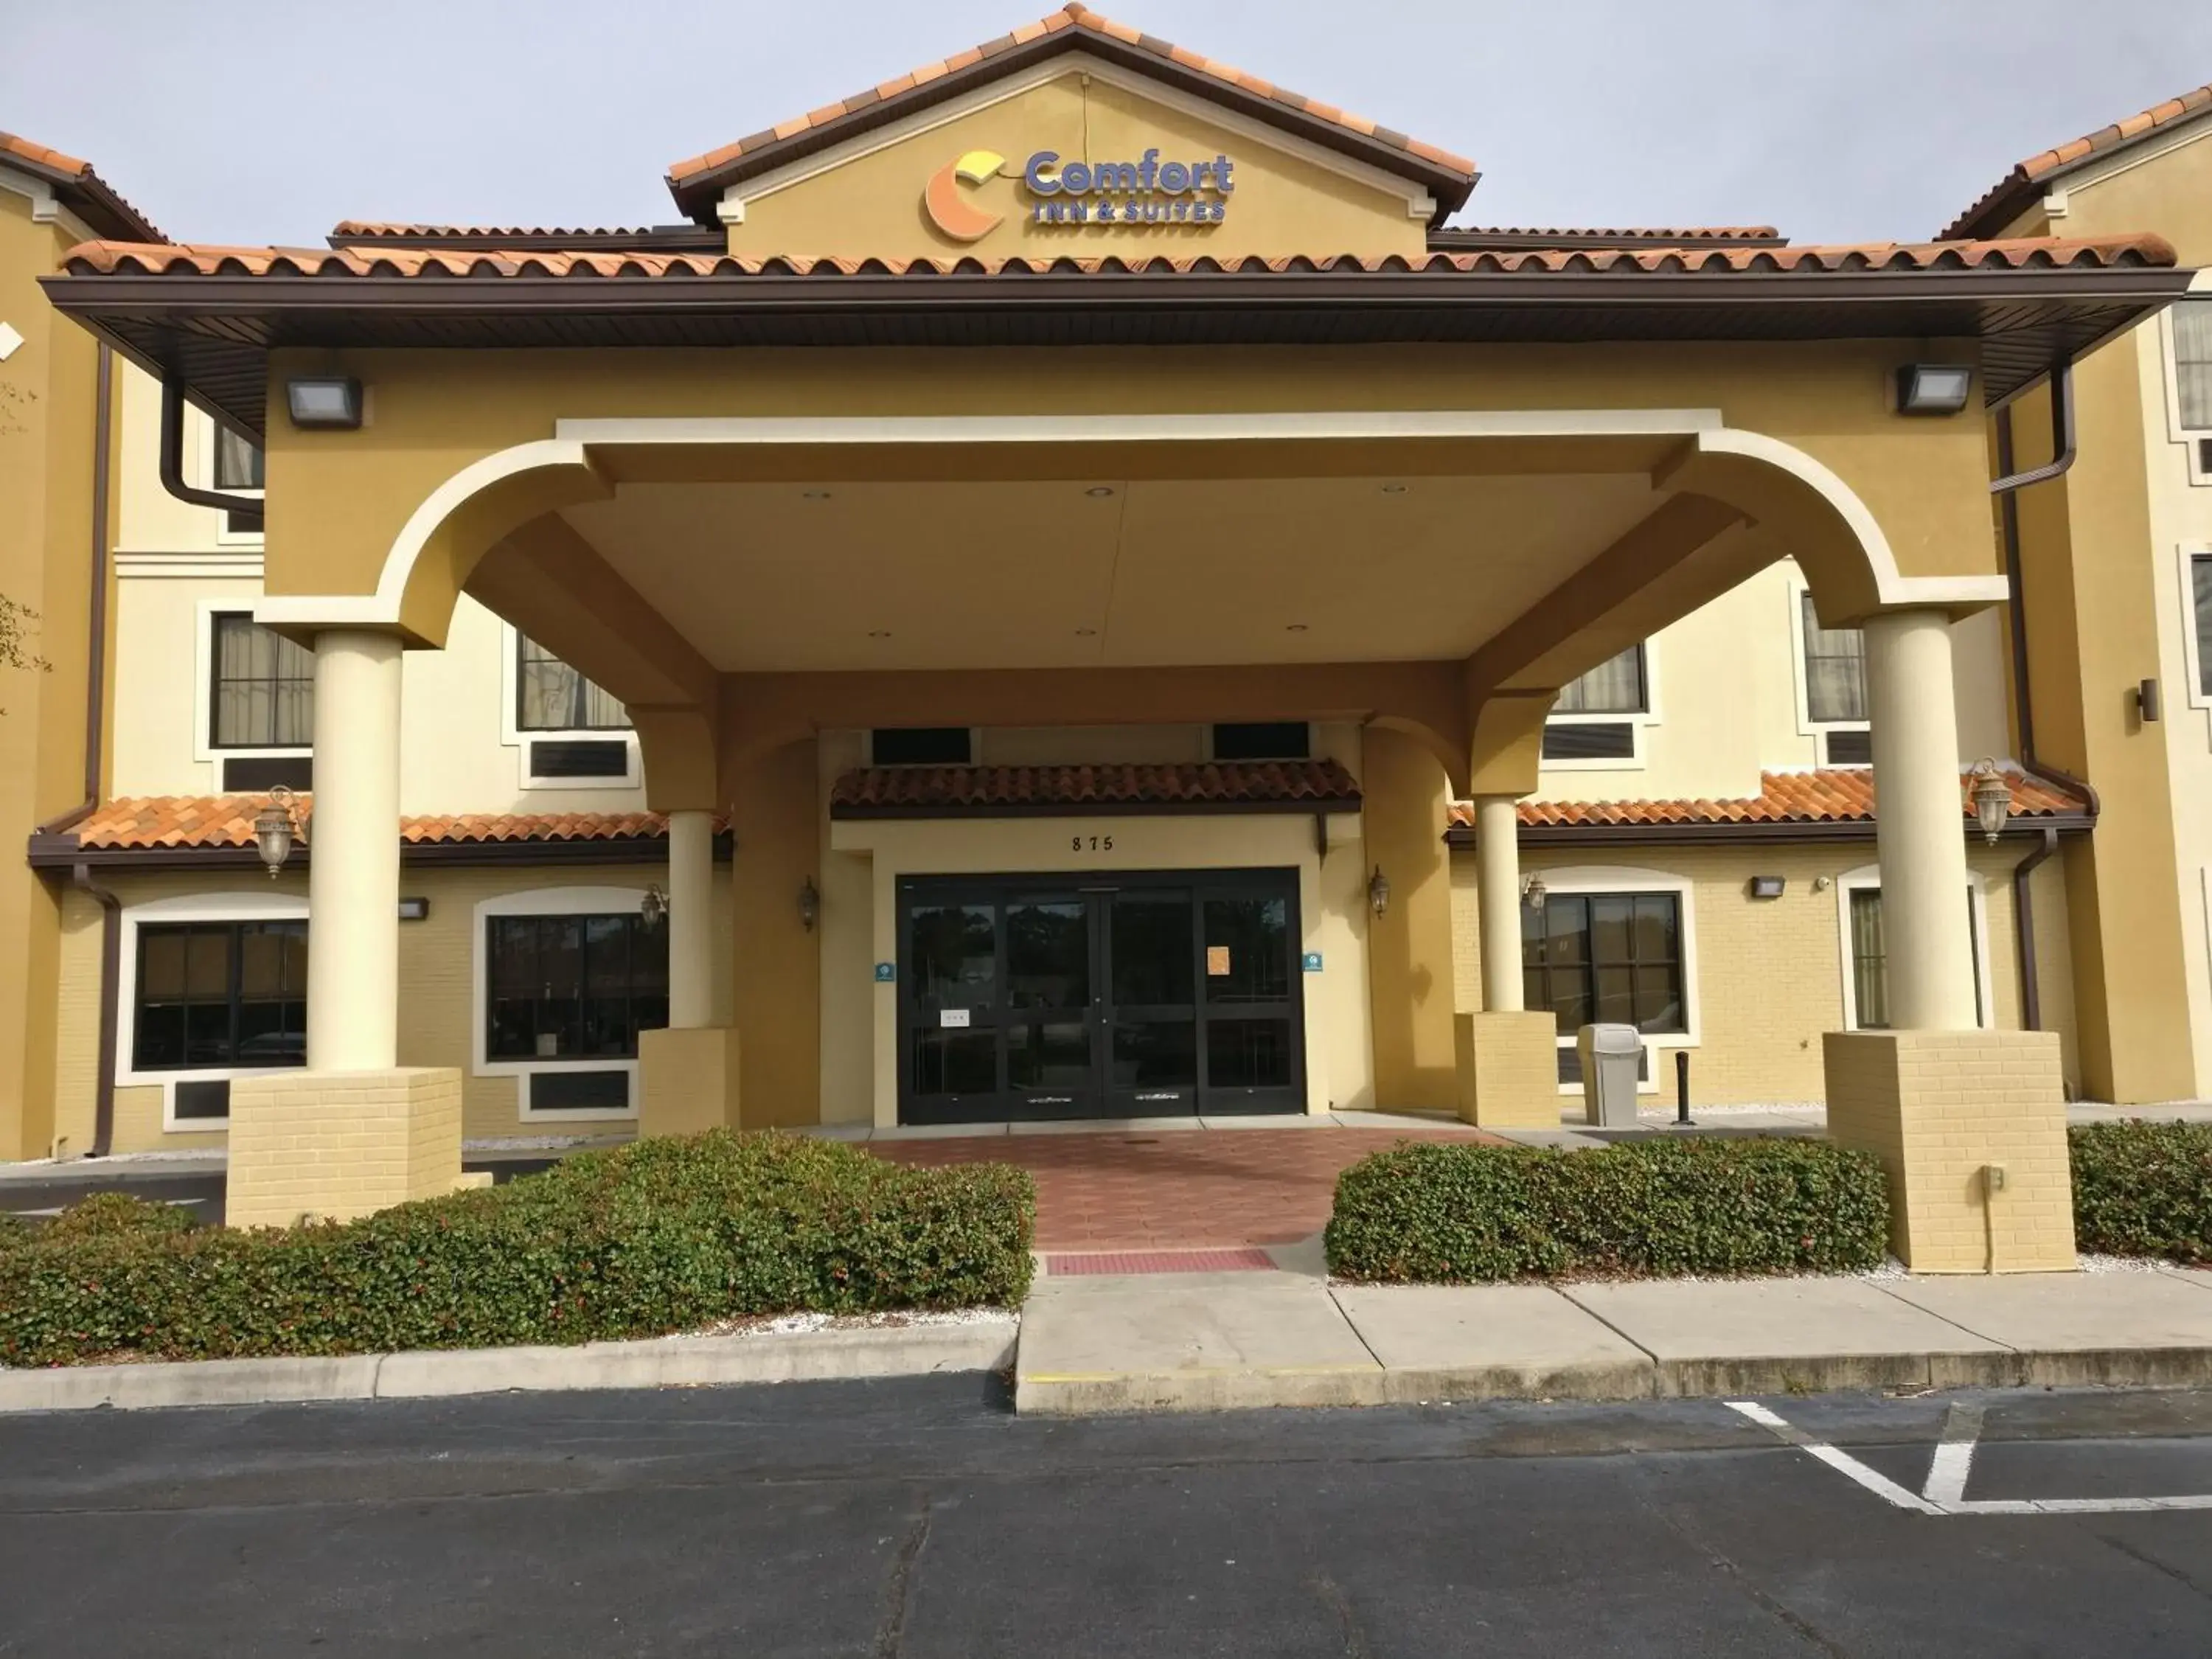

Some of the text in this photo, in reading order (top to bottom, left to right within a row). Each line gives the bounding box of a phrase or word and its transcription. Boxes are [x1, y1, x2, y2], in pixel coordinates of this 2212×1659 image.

[1026, 149, 1234, 194] Comfort
[1034, 200, 1225, 221] INN & SUITES
[1072, 835, 1113, 852] 875
